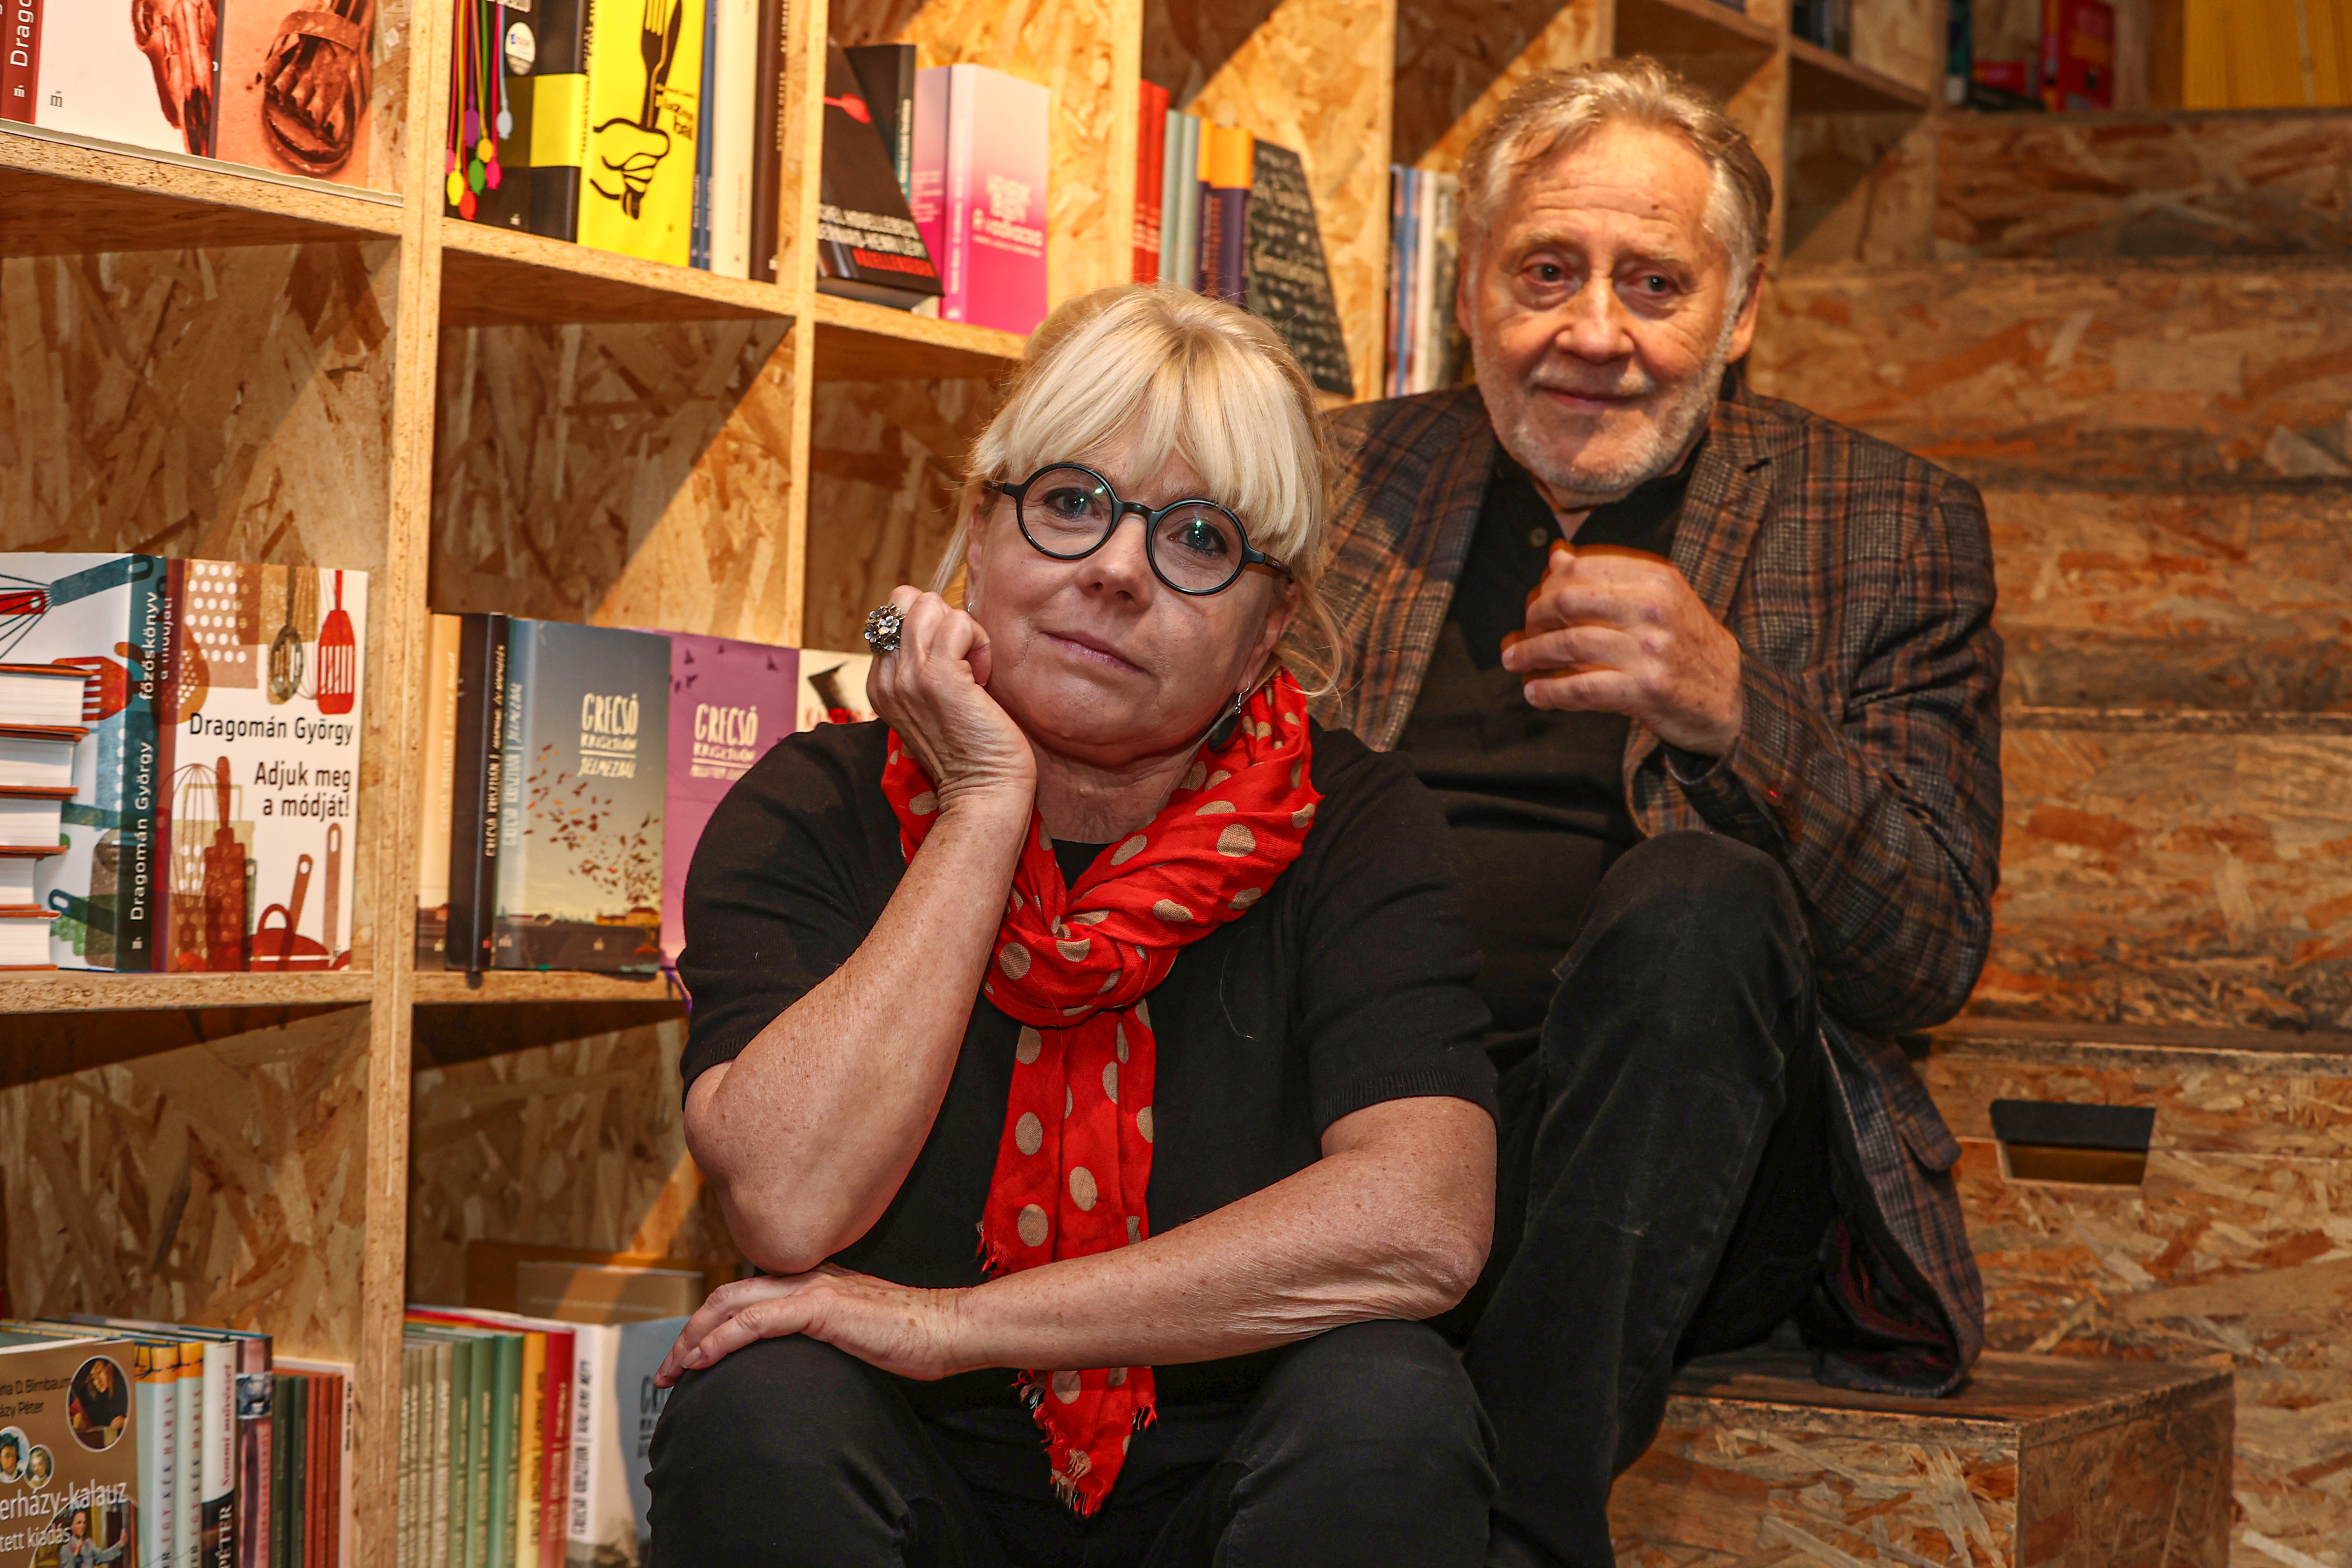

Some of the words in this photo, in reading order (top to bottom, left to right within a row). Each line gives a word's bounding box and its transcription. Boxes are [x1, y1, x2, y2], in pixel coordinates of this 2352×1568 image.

[139, 591, 159, 700] főzőskönyv
[190, 712, 287, 742] Dragomán
[294, 716, 353, 746] György
[582, 692, 640, 736] GRECSÓ
[694, 703, 759, 747] GRECSÓ
[135, 741, 154, 810] György
[254, 761, 309, 791] Adjuk
[314, 769, 351, 792] meg
[262, 798, 273, 816] a
[280, 791, 350, 822] módját!
[130, 818, 149, 921] Dragomán
[27, 1522, 72, 1548] kiadás
